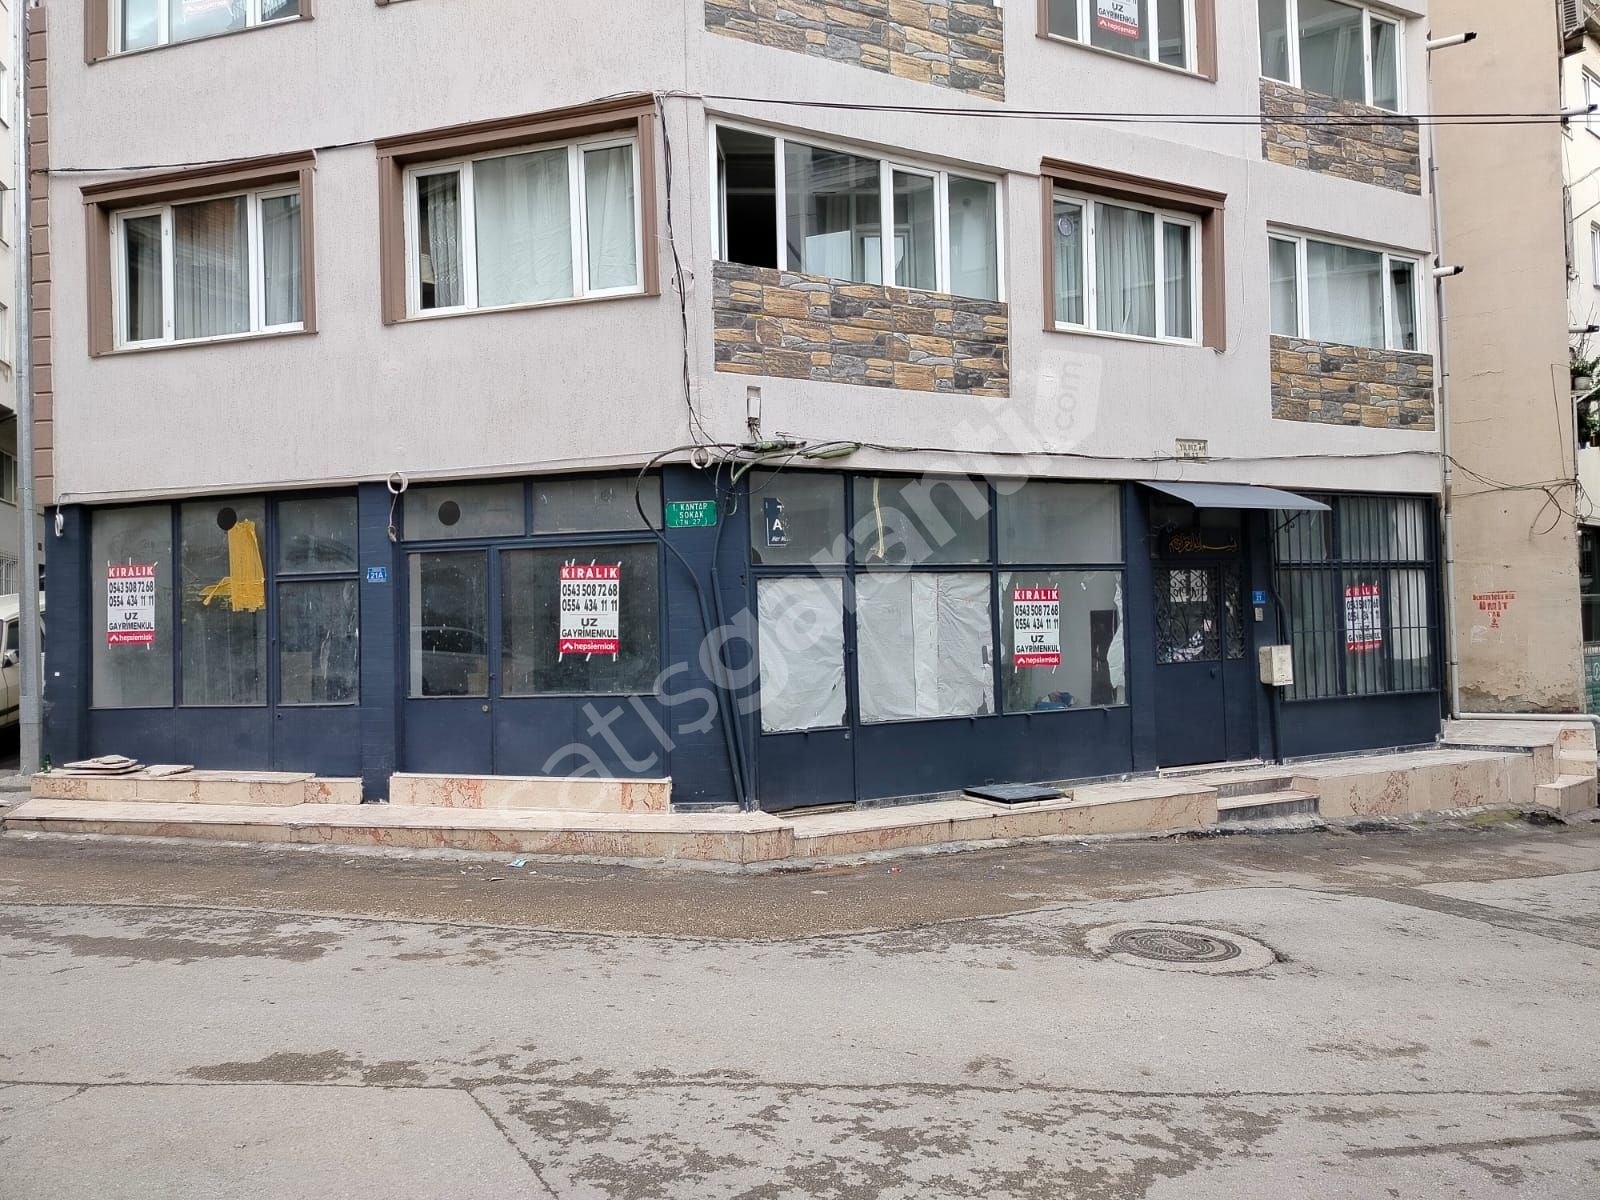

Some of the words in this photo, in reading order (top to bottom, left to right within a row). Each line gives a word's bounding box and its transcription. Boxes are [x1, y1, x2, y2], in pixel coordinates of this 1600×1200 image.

[1112, 2, 1124, 12] UZ
[680, 502, 708, 511] KANTAR
[679, 511, 704, 519] SOKAK
[109, 581, 124, 593] 0543
[125, 581, 137, 593] 508
[138, 581, 145, 593] 72
[146, 581, 153, 593] 68
[562, 584, 580, 596] 0543
[582, 584, 596, 596] 508
[598, 584, 607, 596] 72
[608, 584, 618, 596] 68
[109, 595, 124, 607] 0554
[127, 595, 138, 607] 434
[141, 595, 146, 607] 11
[148, 595, 154, 607] 11
[562, 600, 580, 612] 0554
[584, 600, 598, 612] 434
[601, 600, 607, 612] 11
[612, 600, 617, 612] 11
[1015, 605, 1030, 616] 0543
[1031, 605, 1042, 616] 508
[1044, 605, 1050, 616] 72
[1051, 605, 1058, 616] 68
[124, 612, 138, 620] UZ
[581, 618, 598, 626] UZ
[1015, 619, 1030, 630] 0554
[1033, 619, 1043, 630] 434
[1046, 619, 1051, 630] 11
[1054, 619, 1058, 630] 11
[119, 634, 152, 643] hepsiemlak
[1030, 635, 1044, 643] UZ
[574, 642, 615, 651] hepsiemlak
[1025, 657, 1059, 665] hepsiemlak
